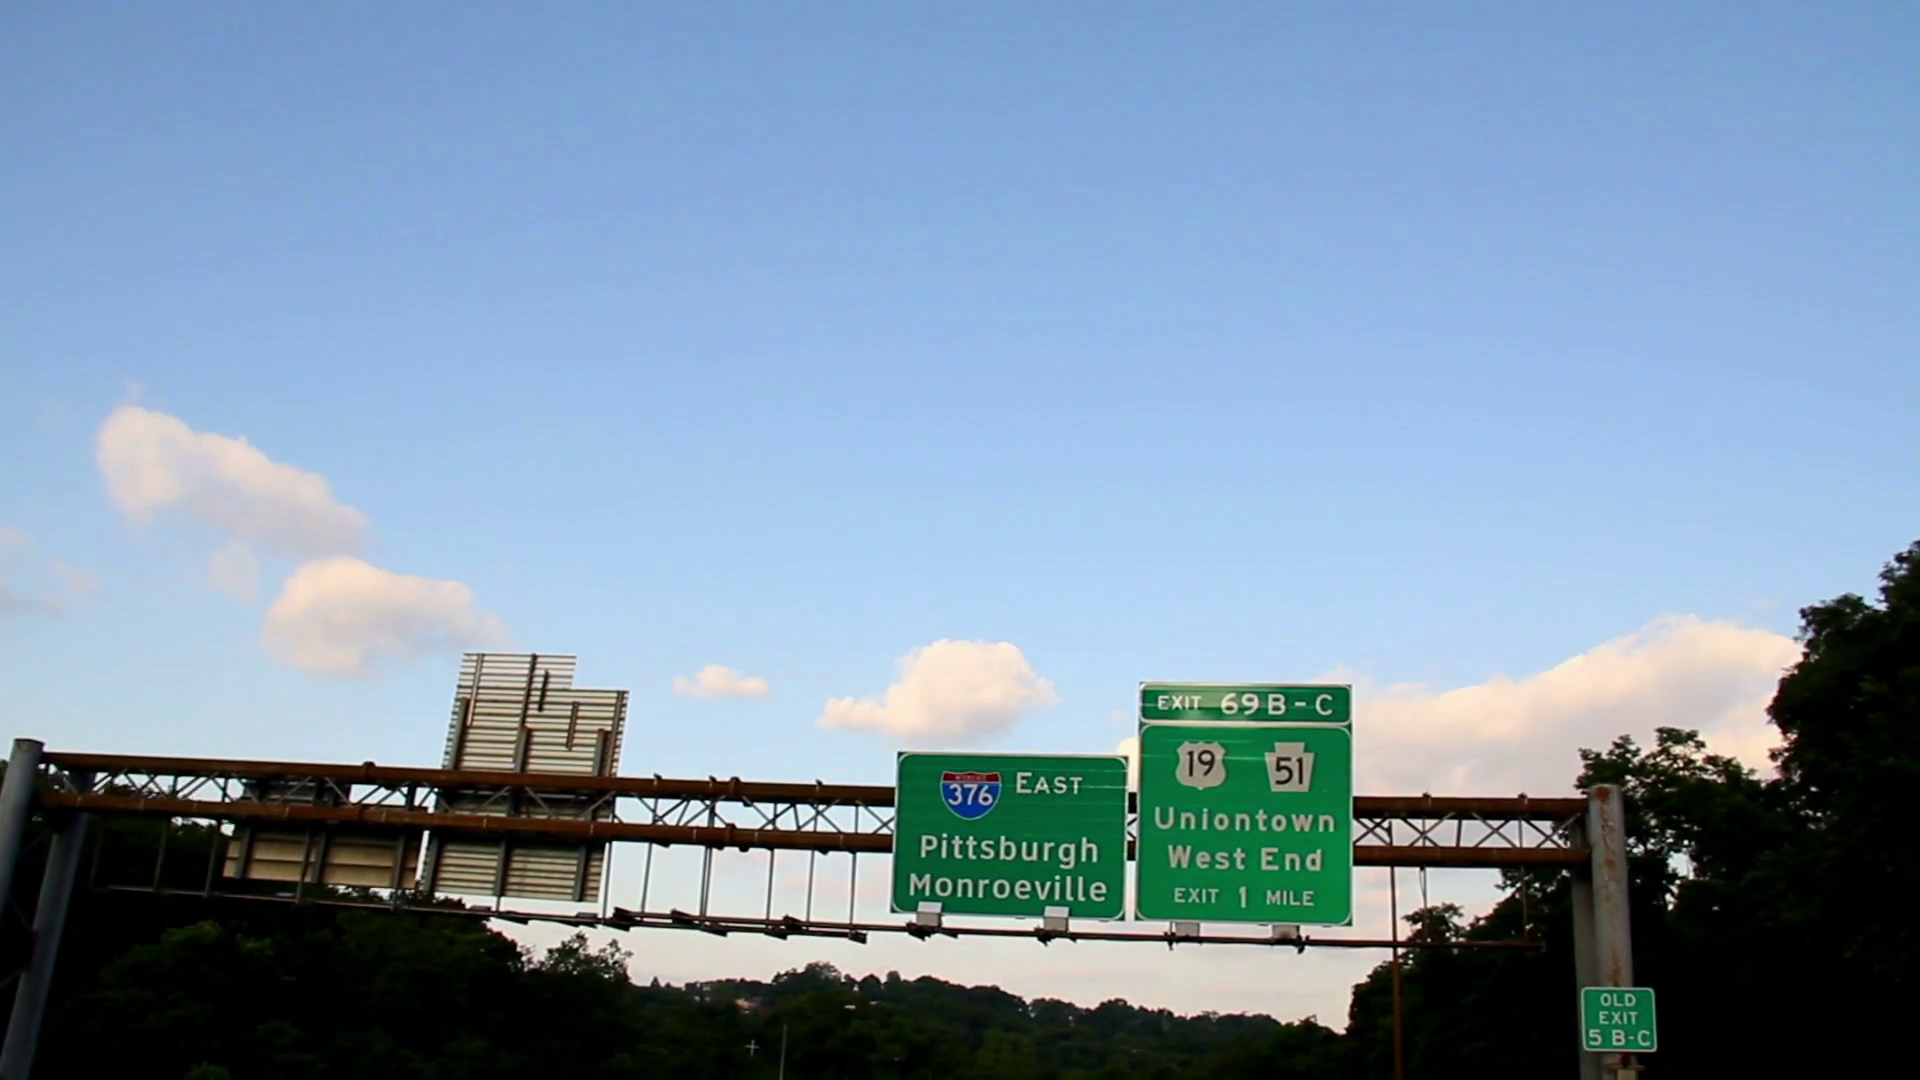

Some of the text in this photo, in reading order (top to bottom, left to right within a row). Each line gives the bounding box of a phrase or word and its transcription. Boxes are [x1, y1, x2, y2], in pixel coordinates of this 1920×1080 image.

[1158, 695, 1201, 711] EXIT
[1187, 750, 1215, 777] 19
[1274, 757, 1305, 785] 51
[948, 783, 993, 806] 376
[1016, 772, 1083, 794] EAST
[1155, 807, 1335, 832] Uniontown
[921, 834, 1099, 869] Pittsburgh
[1168, 845, 1323, 871] West End
[909, 874, 1107, 902] Monroeville
[1174, 886, 1314, 908] EXIT 1 MILE
[1600, 993, 1636, 1007] OLD
[1599, 1011, 1638, 1025] EXIT
[1589, 1029, 1650, 1046] 5 B-C
